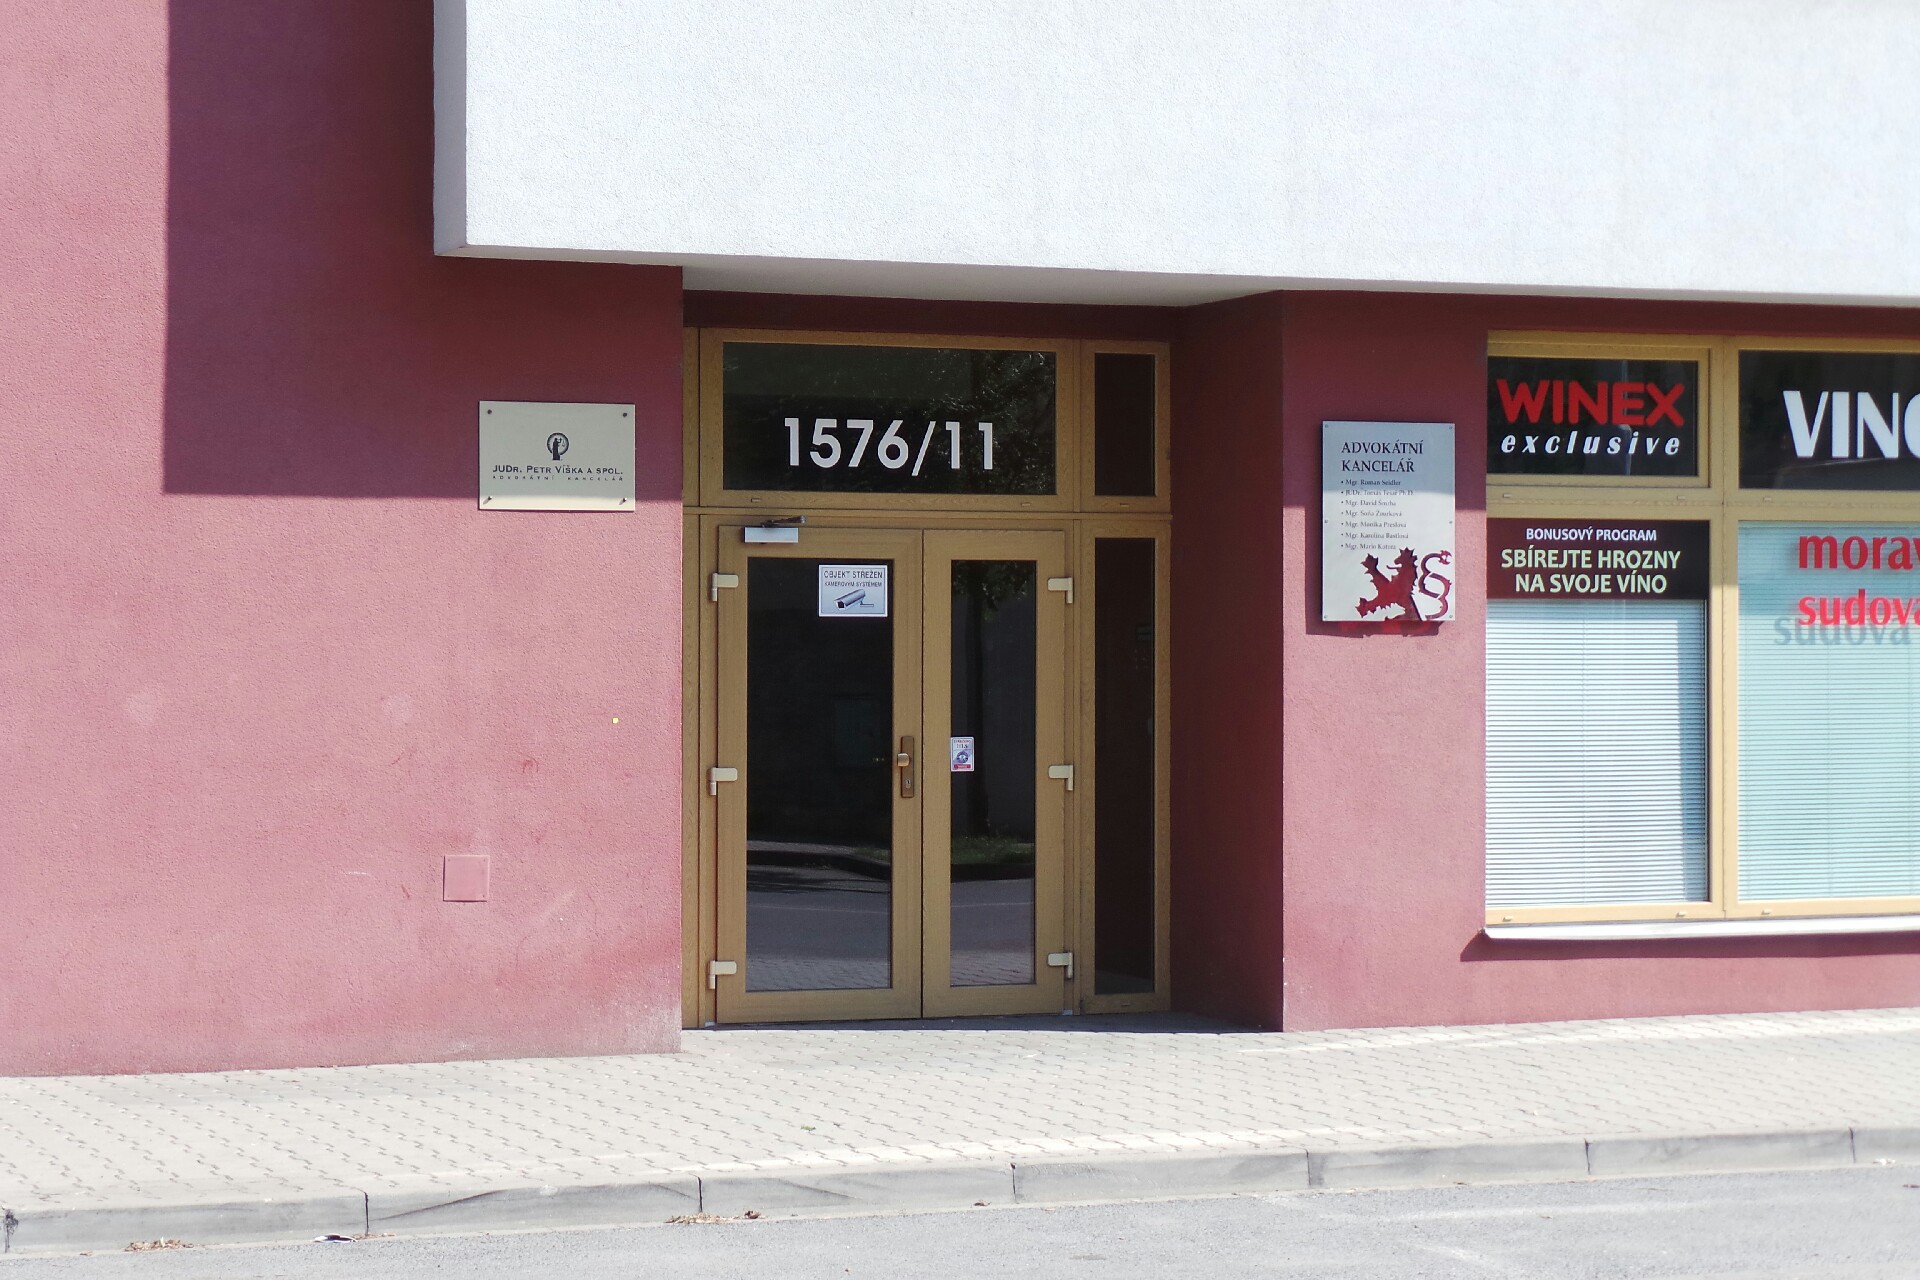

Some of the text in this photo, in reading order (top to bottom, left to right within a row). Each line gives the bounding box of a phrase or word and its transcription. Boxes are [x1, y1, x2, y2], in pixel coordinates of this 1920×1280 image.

[1496, 379, 1685, 427] WINEX
[784, 417, 993, 477] 1576/11
[1341, 440, 1424, 455] ADVOKÁTNÍ
[1501, 431, 1681, 455] exclusive
[1341, 458, 1415, 473] KANCELÁŘ
[1526, 526, 1657, 541] BONUSOVÝ PROGRAM
[1501, 545, 1681, 569] SBÍREJTE HROZNY
[824, 570, 882, 579] OBJEKT STŘEŽEN
[1515, 570, 1668, 593] NA SVOJE VÍNO
